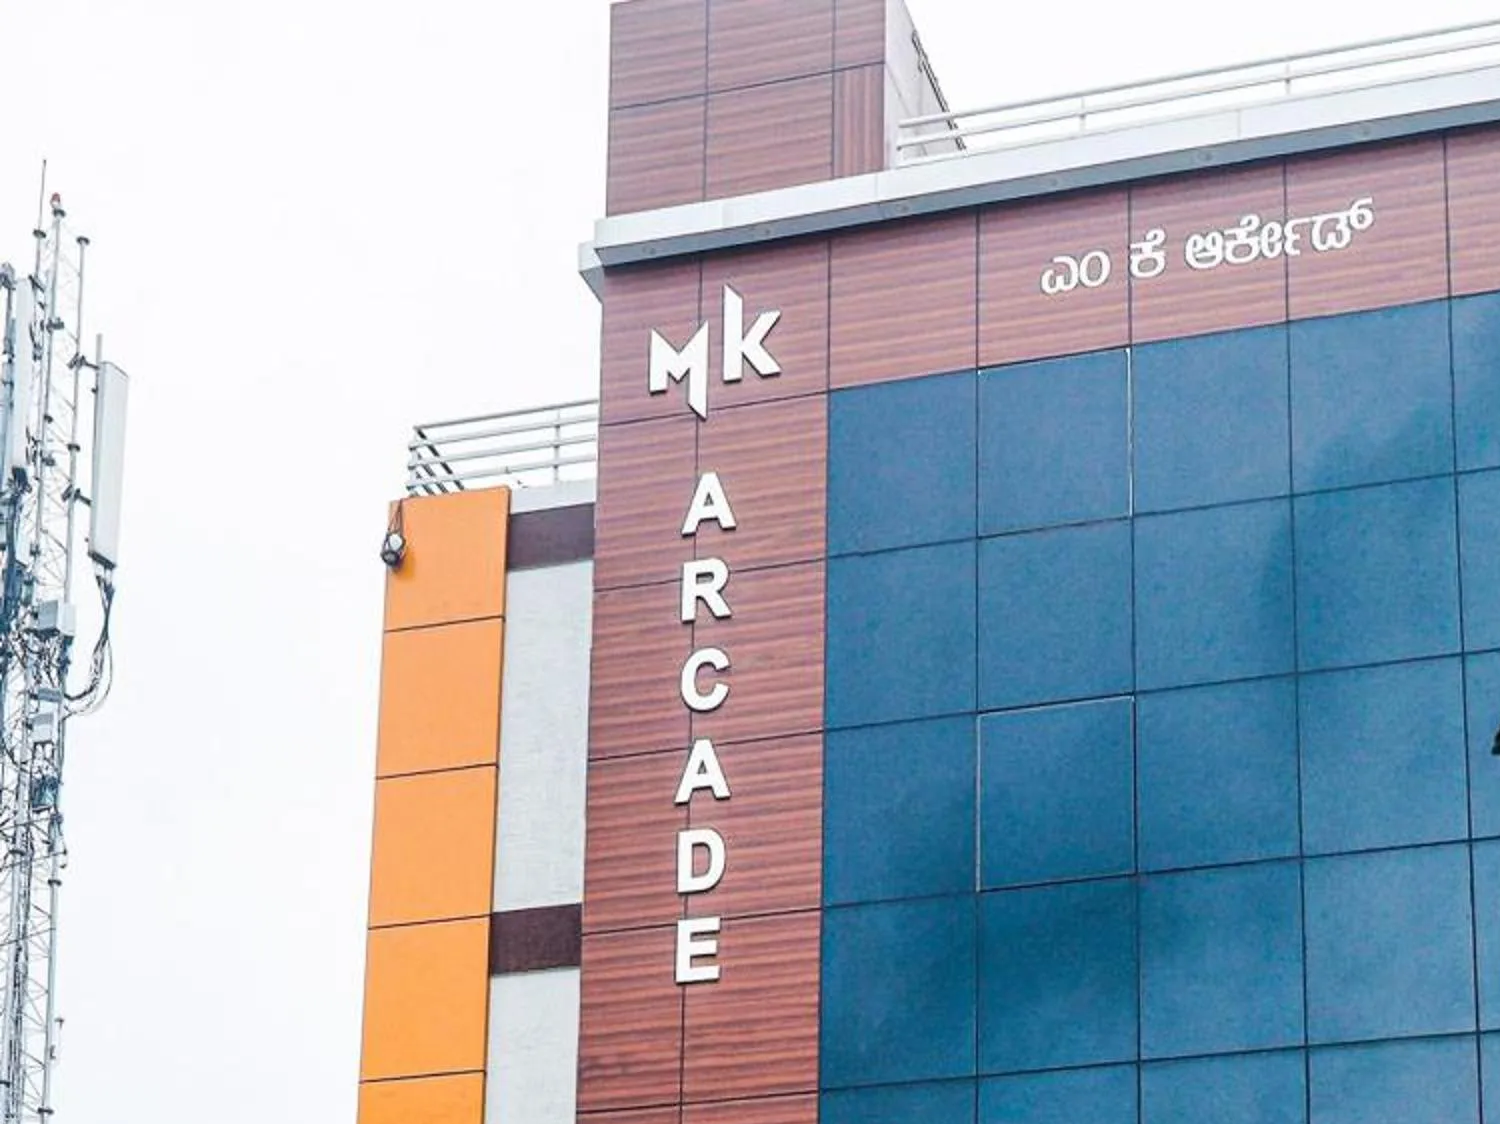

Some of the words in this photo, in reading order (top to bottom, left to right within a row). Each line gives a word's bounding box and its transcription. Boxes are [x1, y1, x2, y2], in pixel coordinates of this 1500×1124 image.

[1041, 249, 1111, 294] ಎಂ
[1129, 228, 1166, 278] ಕೆ
[674, 472, 737, 984] ARCADE
